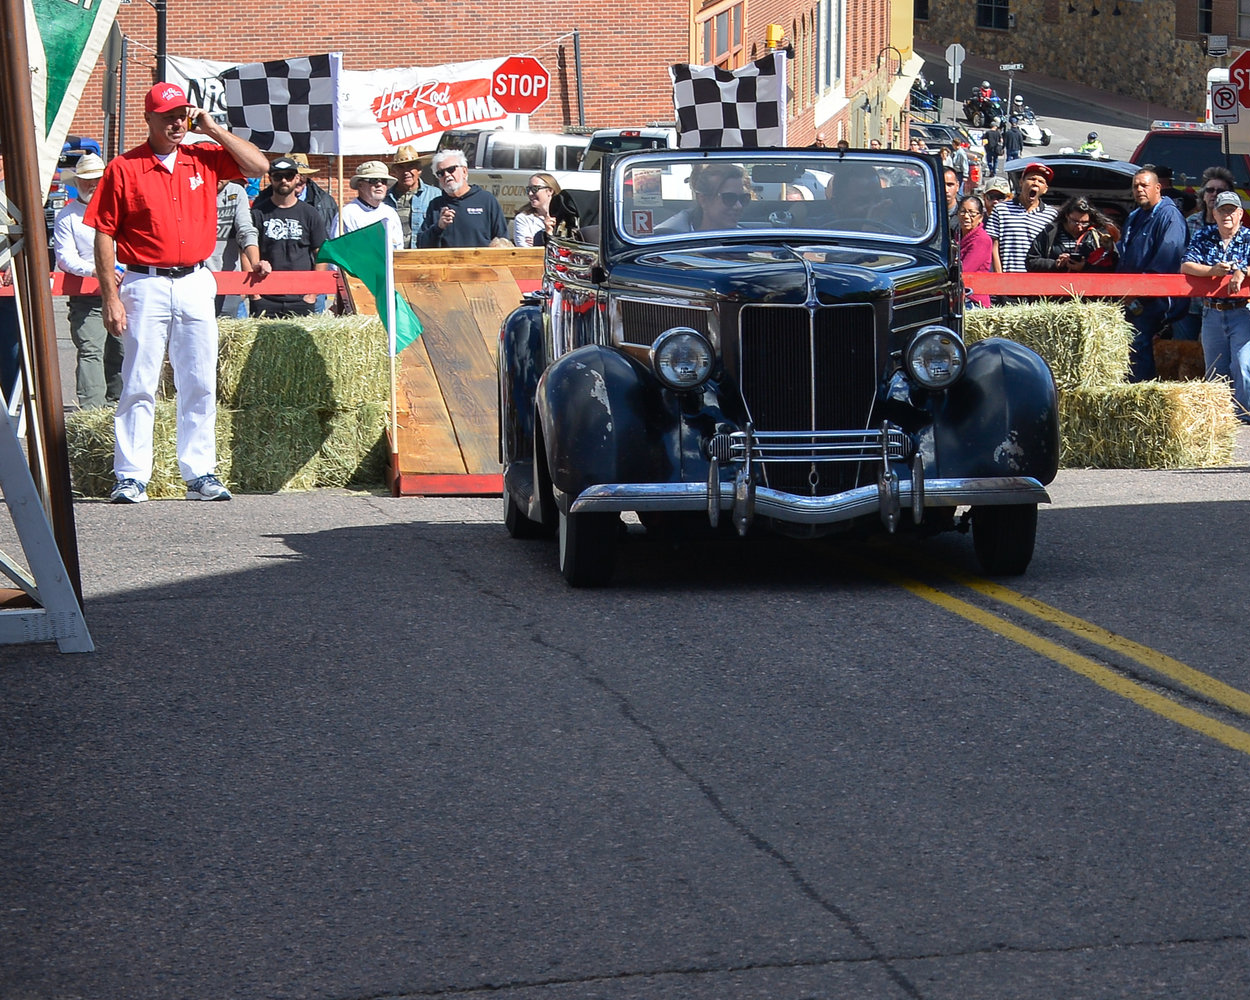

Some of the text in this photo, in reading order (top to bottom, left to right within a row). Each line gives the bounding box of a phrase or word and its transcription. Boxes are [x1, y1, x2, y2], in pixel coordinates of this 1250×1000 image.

[376, 79, 451, 117] Hot Rod
[494, 73, 546, 97] STOP
[387, 95, 503, 142] HILL CLIMB
[634, 212, 649, 231] R
